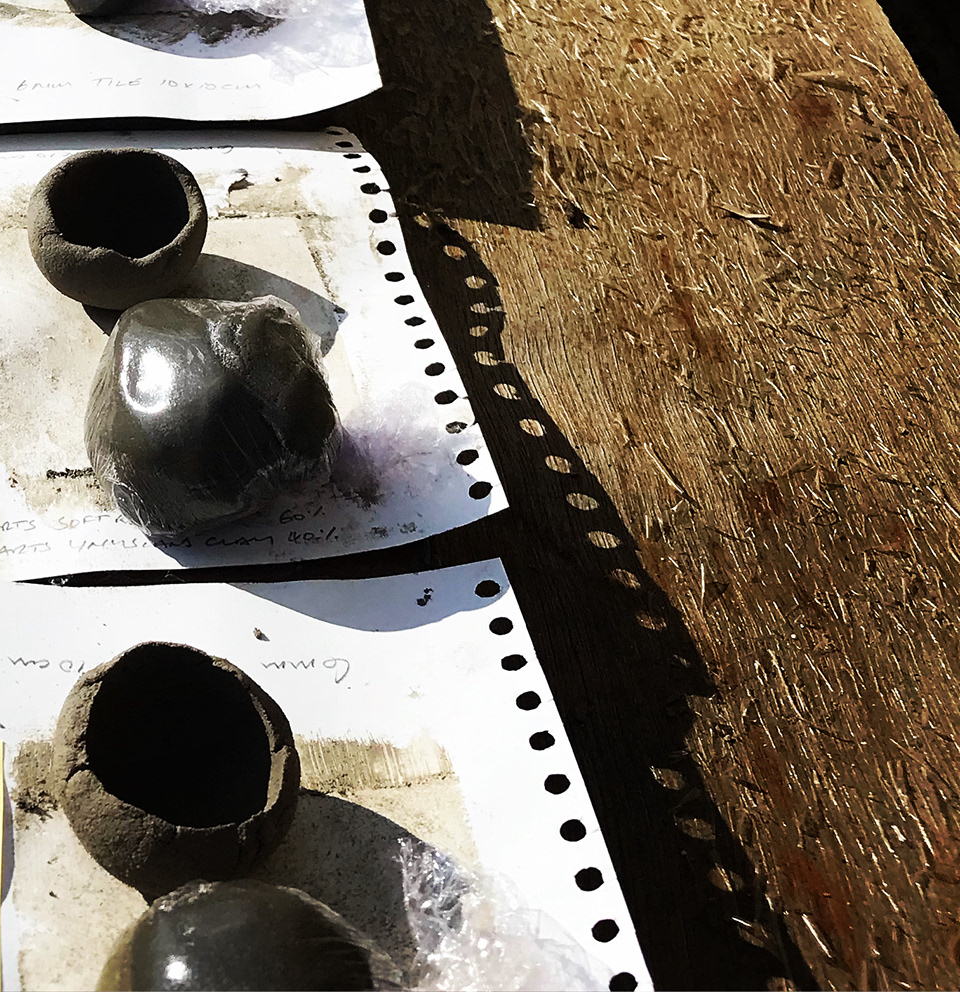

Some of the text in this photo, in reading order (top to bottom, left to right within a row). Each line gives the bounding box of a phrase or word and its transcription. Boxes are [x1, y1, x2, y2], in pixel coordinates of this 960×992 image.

[92, 77, 144, 87] TILE
[53, 514, 110, 531] SOFT
[206, 536, 274, 548] CLAY
